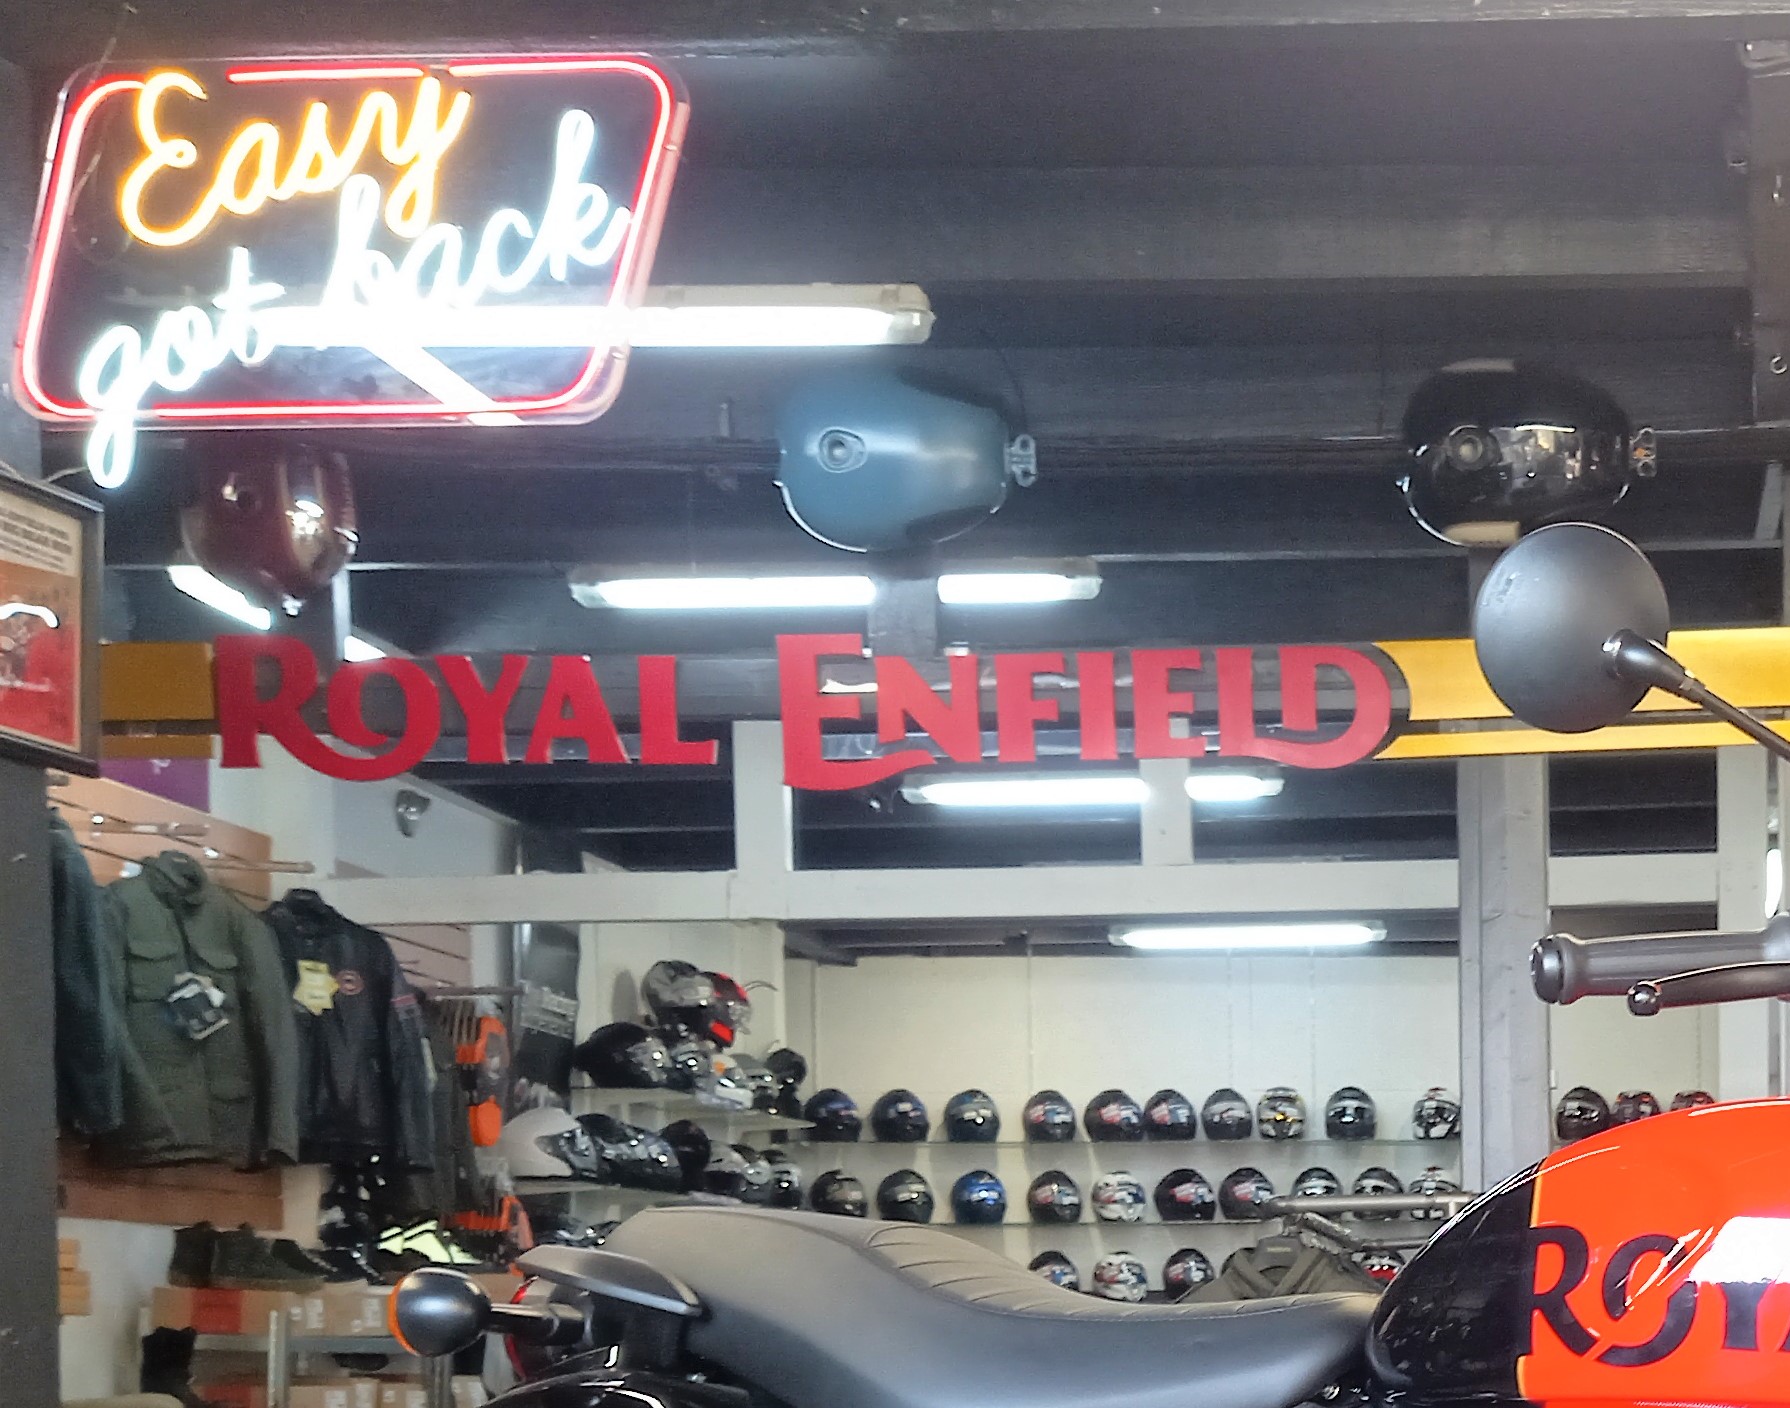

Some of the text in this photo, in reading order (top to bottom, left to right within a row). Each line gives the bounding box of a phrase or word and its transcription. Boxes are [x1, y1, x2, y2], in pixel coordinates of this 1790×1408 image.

[118, 68, 470, 247] Easy
[77, 108, 631, 489] got back
[212, 633, 1393, 791] ROYAL ENFIELD
